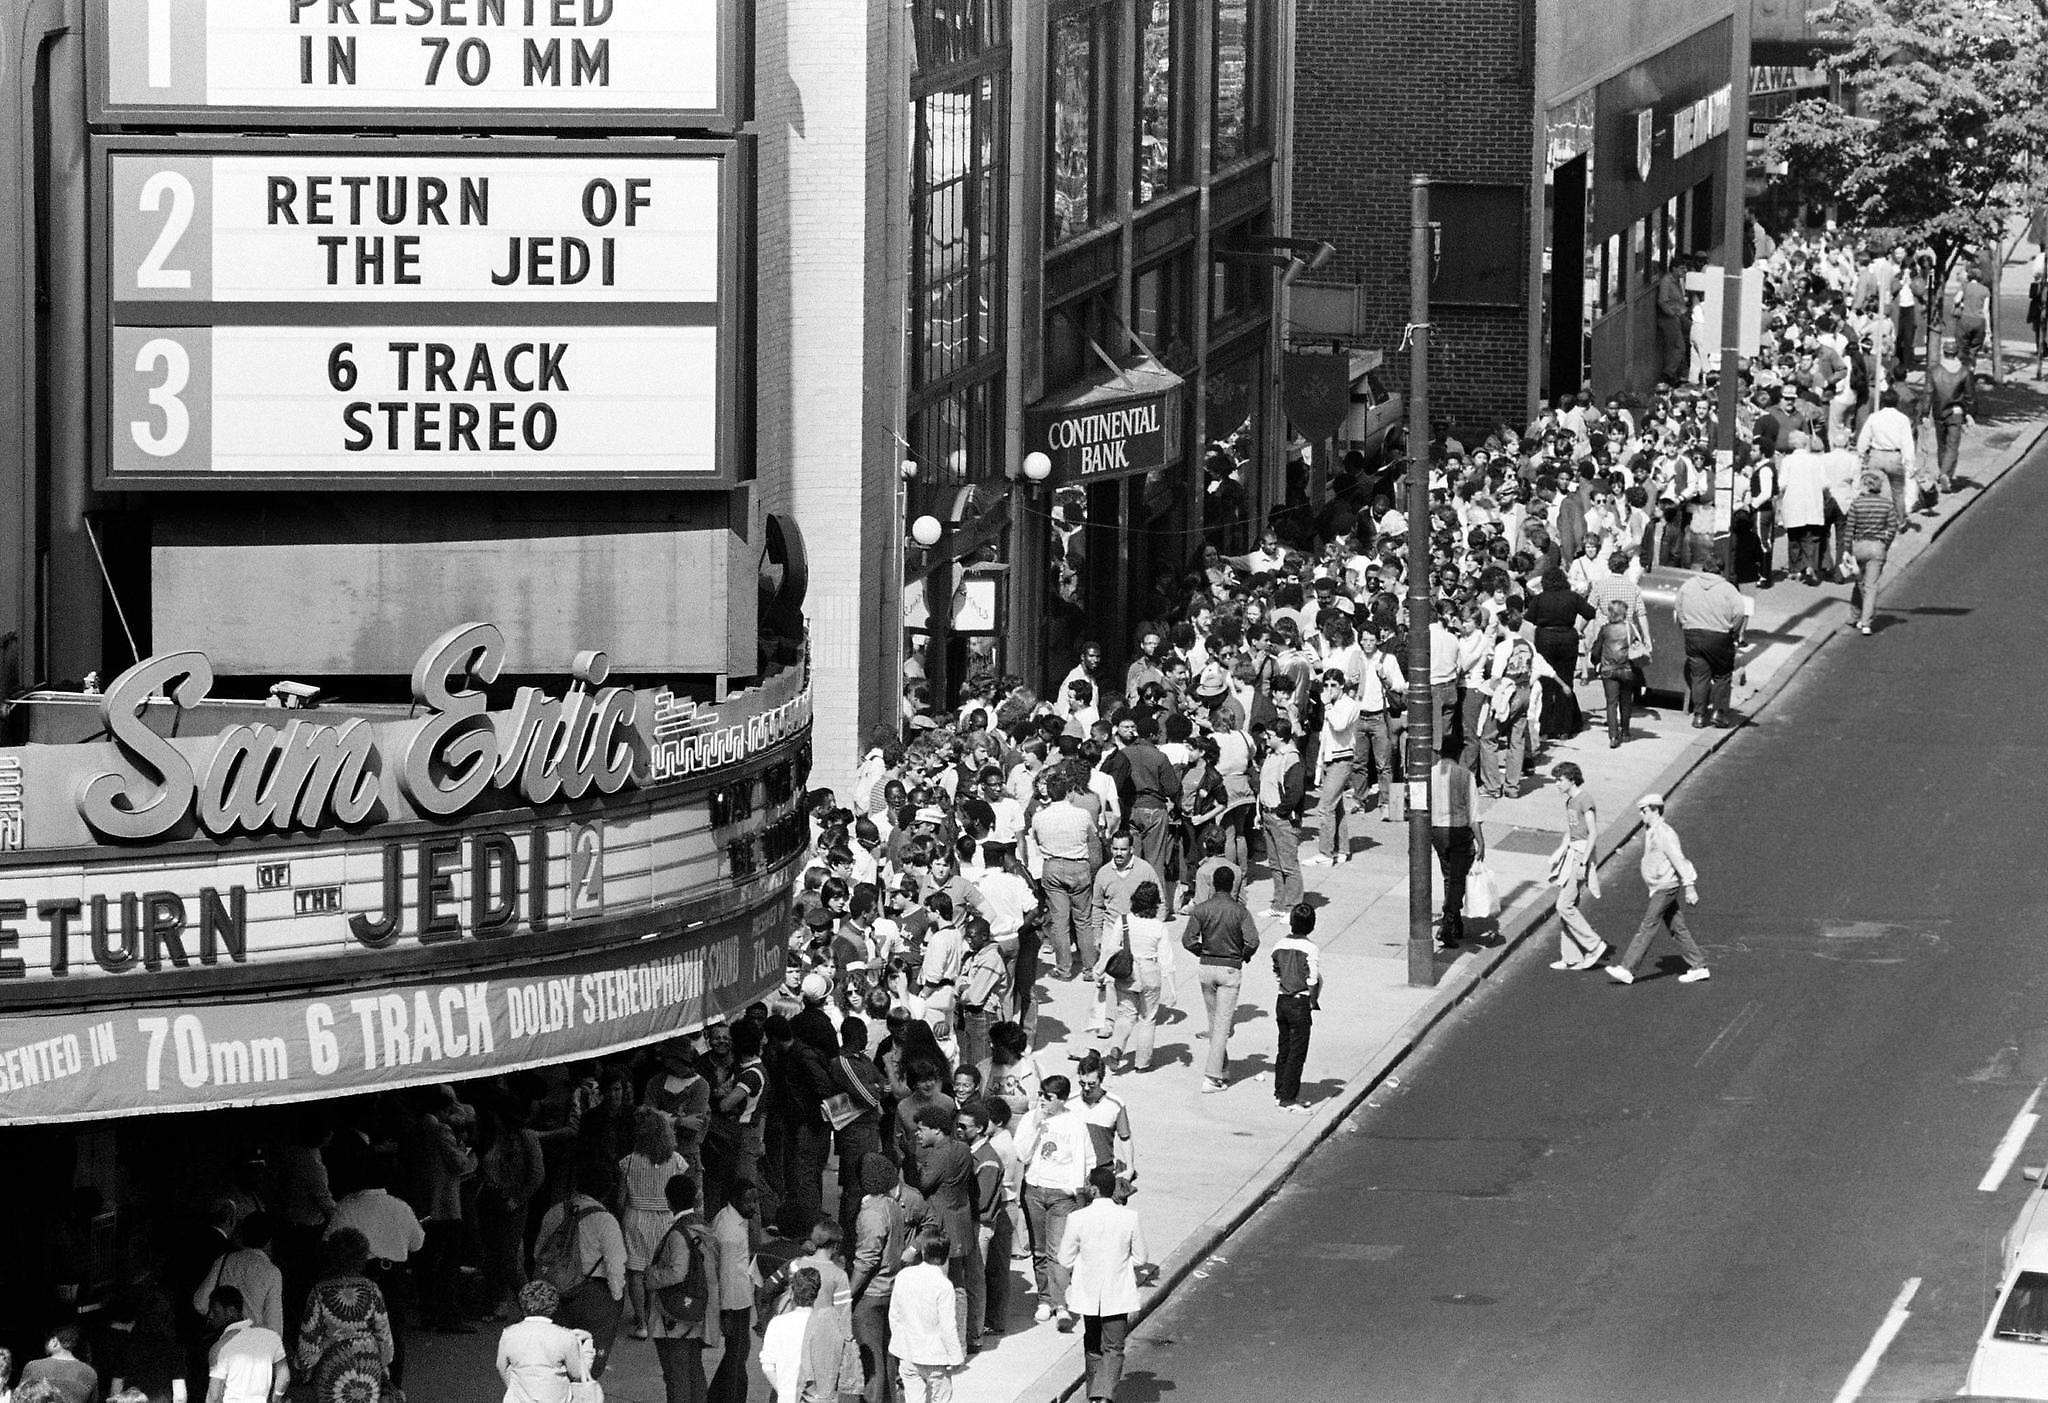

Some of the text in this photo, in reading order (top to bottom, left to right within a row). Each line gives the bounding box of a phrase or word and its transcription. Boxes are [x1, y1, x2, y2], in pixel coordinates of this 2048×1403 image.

[299, 36, 611, 87] IN 70 MM
[266, 176, 653, 227] RETURN OF
[136, 170, 196, 290] 2
[317, 235, 616, 287] THE JEDI
[327, 342, 571, 393] 6 TRACK
[130, 338, 190, 457] 3
[343, 401, 558, 452] STEREO
[1048, 404, 1161, 450] CONTINENTAL
[1081, 439, 1130, 475] BANK
[76, 649, 388, 838] Sam
[397, 622, 638, 815] Eric
[258, 863, 290, 890] OF
[295, 886, 342, 914] THE
[349, 825, 549, 947] JEDI
[87, 1021, 118, 1067] IN
[138, 1013, 288, 1091] 70mm
[306, 1003, 339, 1077] 6
[350, 983, 496, 1069] TRACK
[507, 976, 575, 1039] DOLBY
